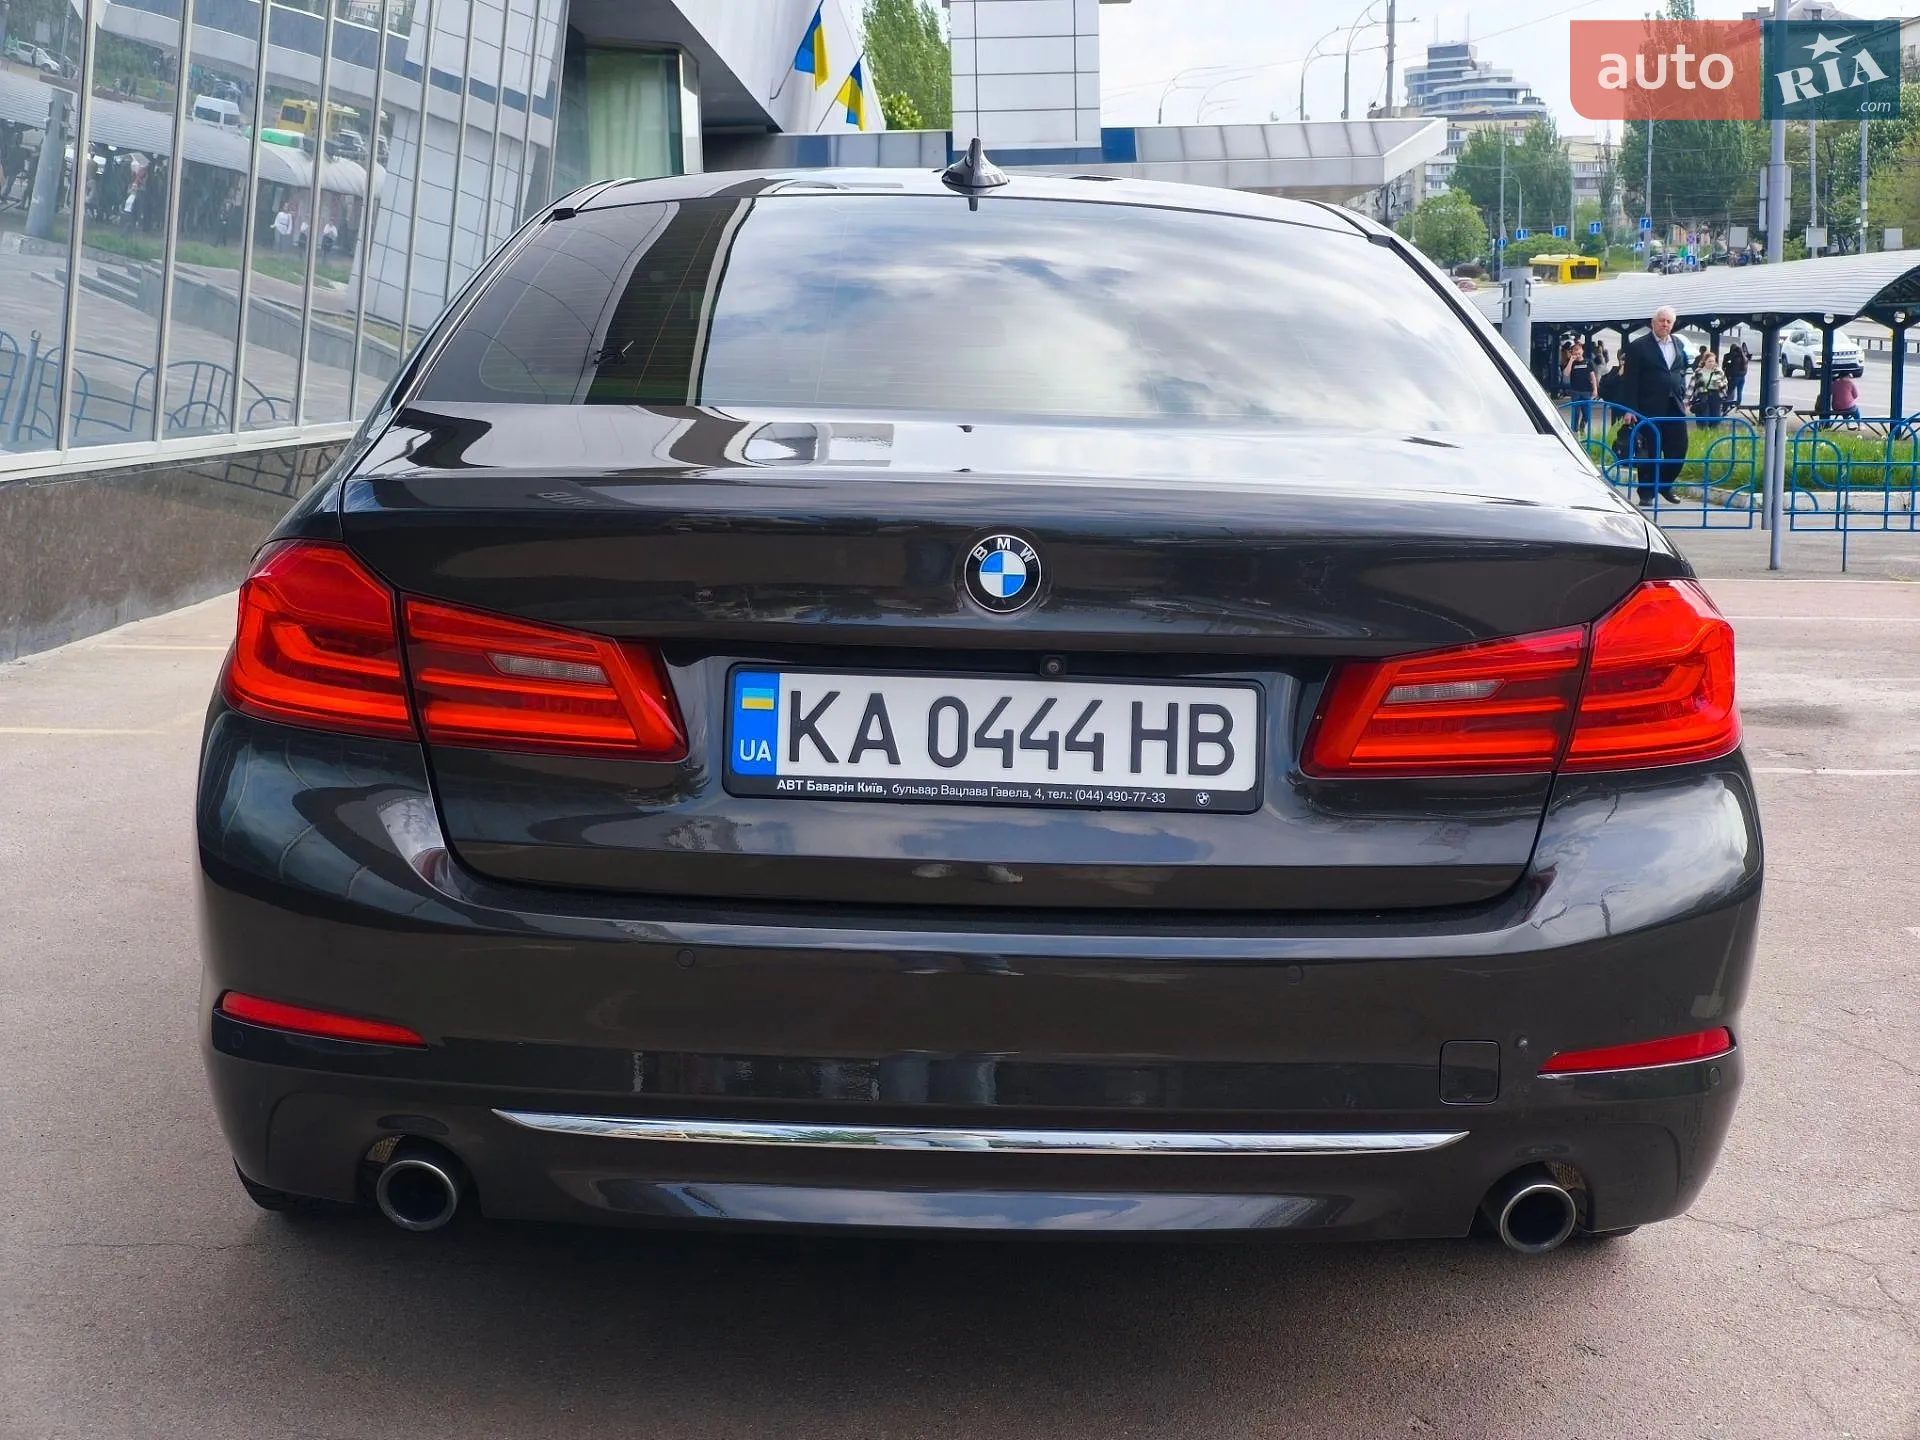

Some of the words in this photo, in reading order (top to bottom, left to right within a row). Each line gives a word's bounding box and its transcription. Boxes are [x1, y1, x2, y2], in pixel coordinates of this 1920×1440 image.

[973, 538, 1035, 563] BMW
[788, 690, 901, 765] KA
[927, 695, 1104, 772] 0444
[1130, 701, 1235, 776] HB
[740, 739, 772, 761] UA
[776, 779, 804, 791] АВТ
[807, 780, 855, 794] Баварія
[857, 781, 887, 795] Київ,
[892, 783, 938, 796] бульвар
[941, 785, 988, 798] Вацлава
[991, 786, 1031, 799] Гавела,
[1034, 788, 1044, 800] 4,
[1047, 789, 1072, 799] тел.:
[1075, 789, 1104, 803] (044)
[1106, 790, 1166, 803] 490-77-33
